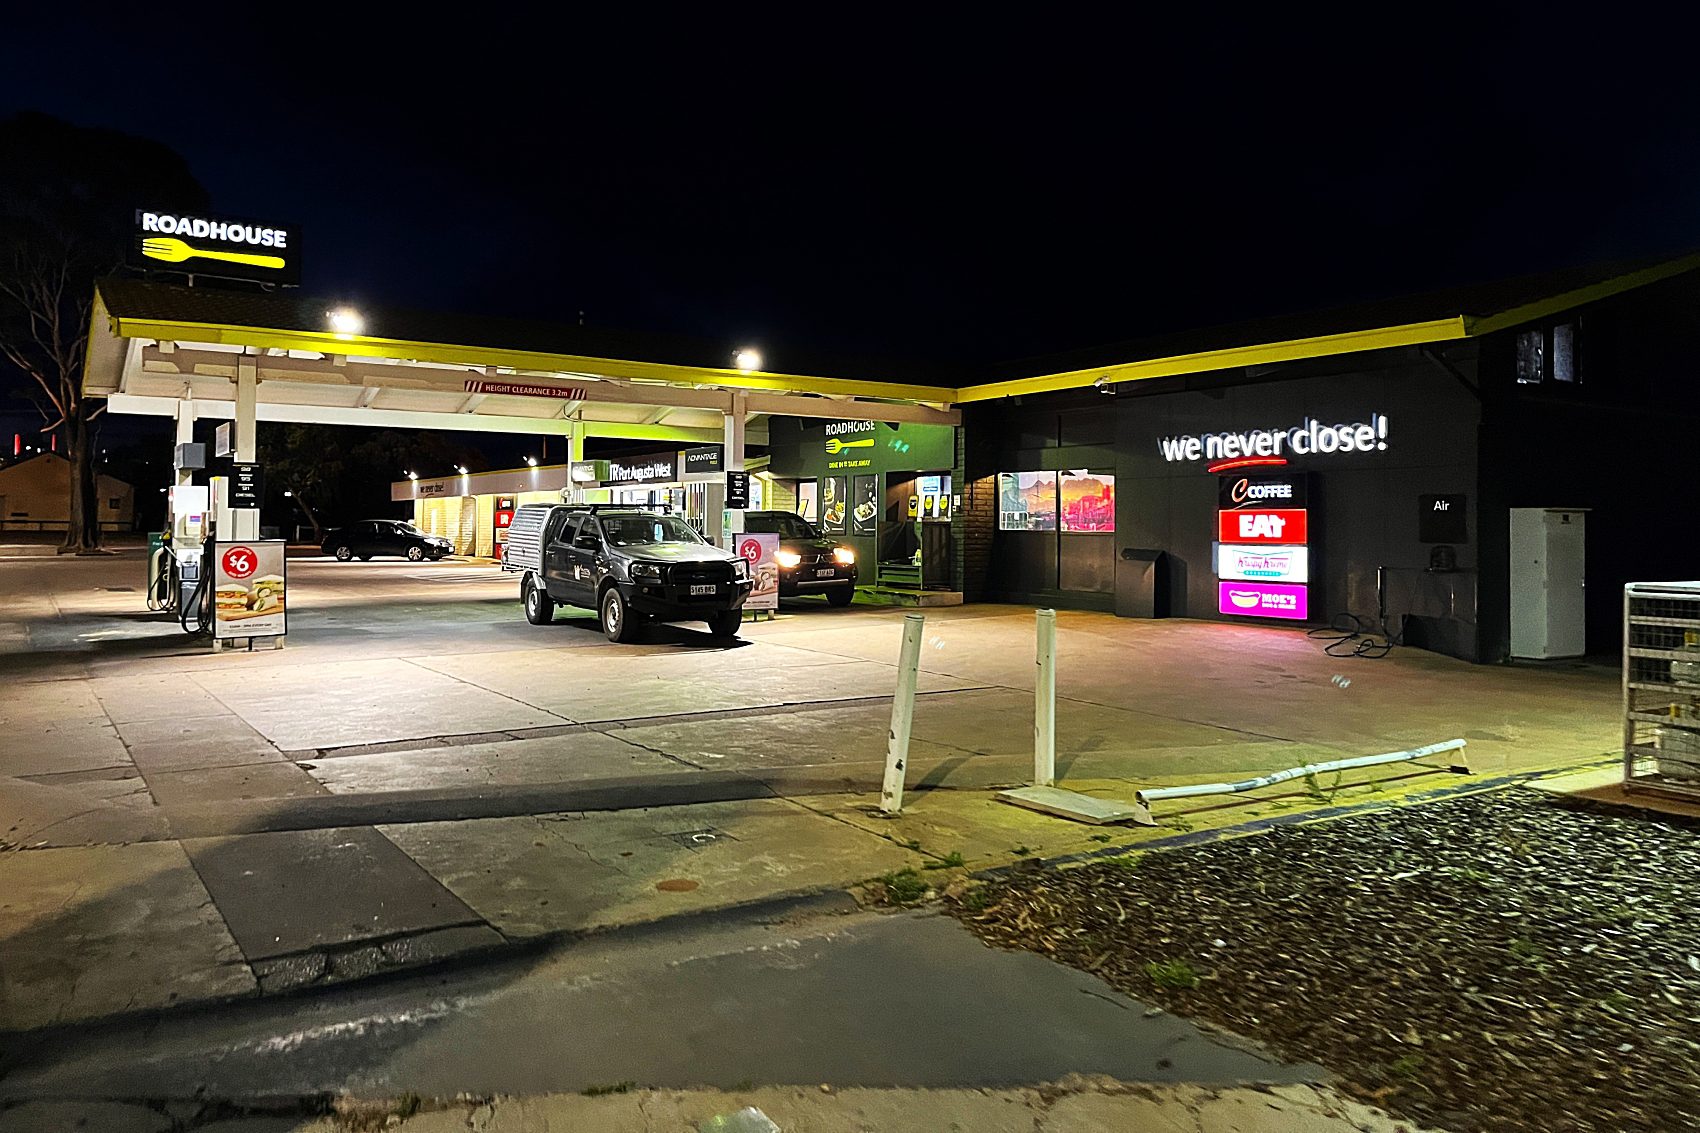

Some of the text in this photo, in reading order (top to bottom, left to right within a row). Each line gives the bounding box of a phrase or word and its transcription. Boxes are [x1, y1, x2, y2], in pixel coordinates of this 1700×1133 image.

[142, 212, 288, 248] ROADHOUSE
[485, 384, 568, 397] HEIGHT CLEARANCE 3.2m
[825, 420, 876, 436] ROADHOUSE
[1162, 415, 1387, 462] we never close!
[619, 466, 633, 481] Port
[632, 465, 654, 482] Augusta
[654, 463, 672, 478] West
[1247, 484, 1293, 499] COFFEE
[1433, 500, 1450, 511] Air
[744, 546, 757, 559] $6
[229, 554, 250, 572] $6
[1261, 593, 1297, 605] MOE'S
